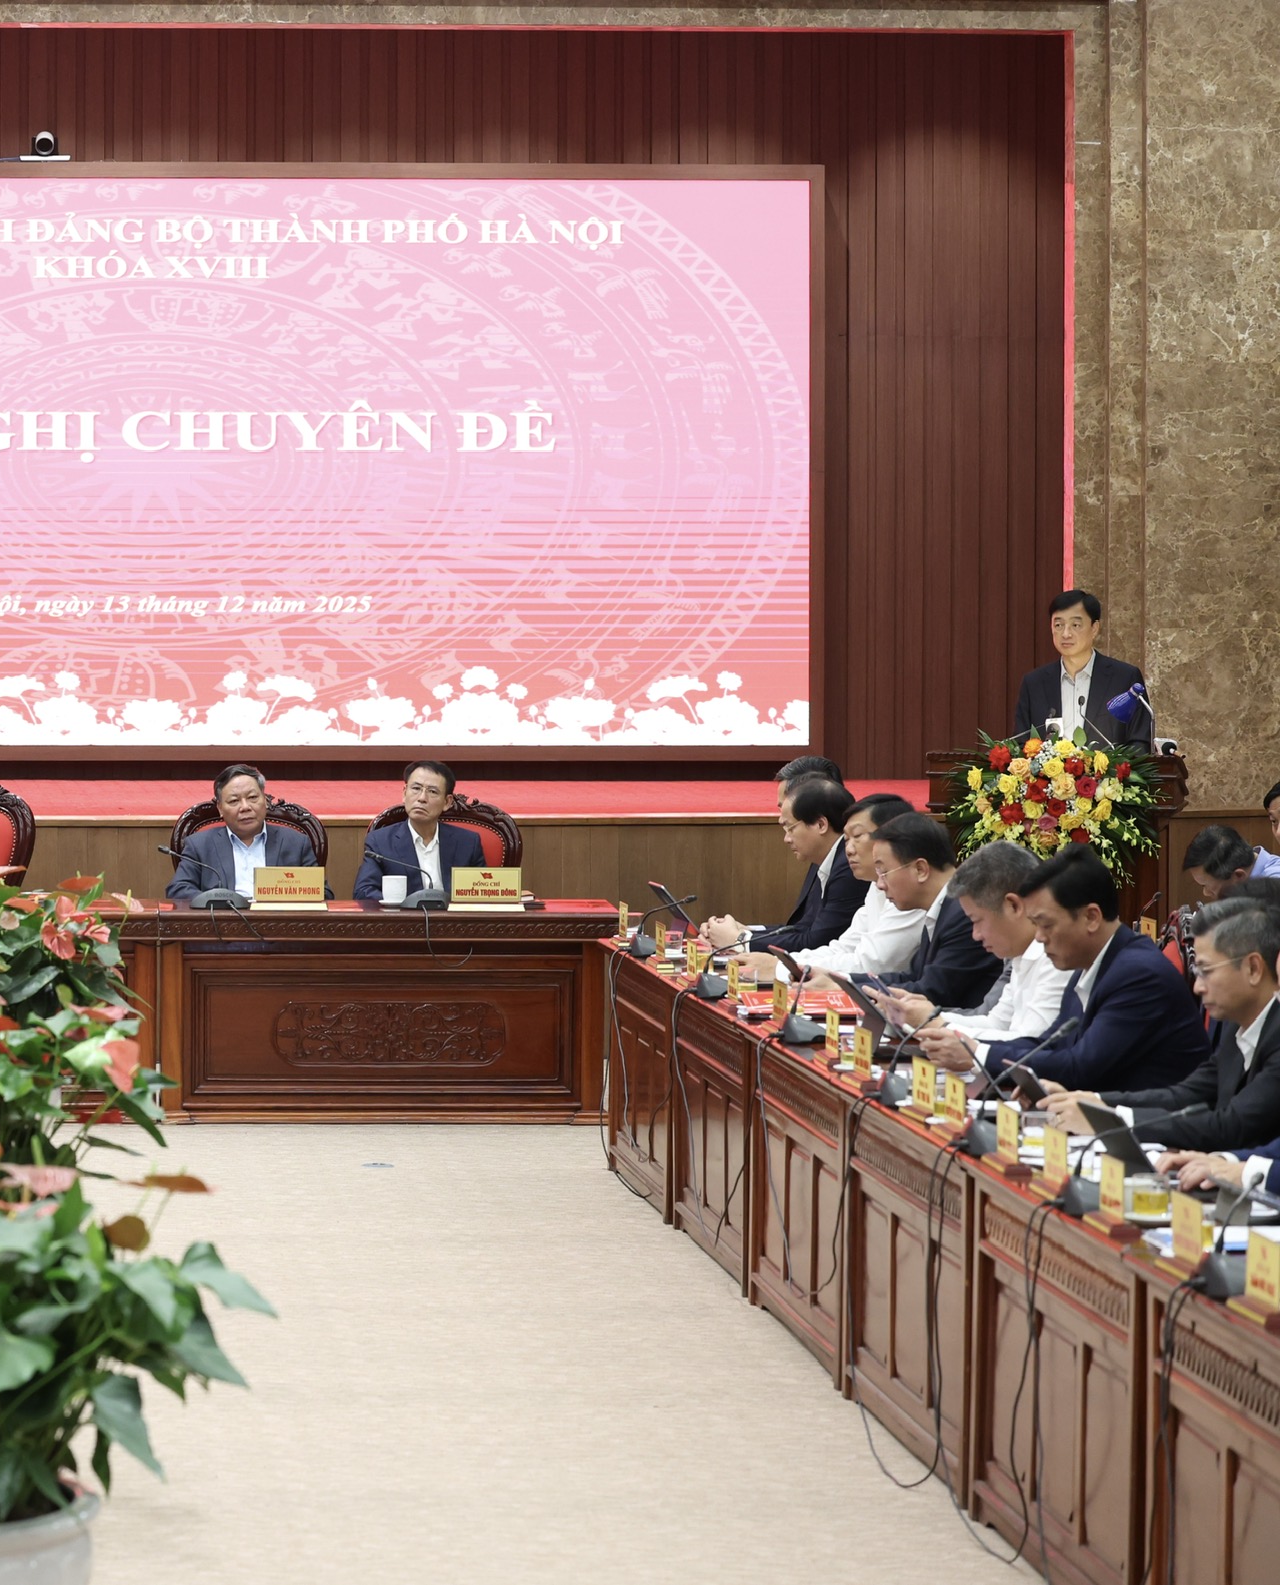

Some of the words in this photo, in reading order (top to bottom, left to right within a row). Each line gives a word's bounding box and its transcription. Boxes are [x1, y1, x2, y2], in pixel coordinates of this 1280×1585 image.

[25, 211, 146, 244] ĐẢNG
[156, 215, 214, 250] BỘ
[223, 212, 370, 244] THÀNH
[381, 212, 469, 244] PHỐ
[478, 212, 539, 244] HÀ
[548, 216, 624, 251] NỘI
[33, 249, 154, 279] KHÓA
[165, 256, 270, 279] XVIII
[121, 400, 437, 453] CHUYÊN
[456, 399, 556, 453] ĐỀ
[34, 596, 95, 617] ngày
[101, 595, 130, 613] 13
[137, 595, 208, 617] tháng
[215, 595, 246, 613] 12
[250, 596, 306, 613] năm
[312, 595, 374, 613] 2025
[257, 884, 283, 895] NGUYỄN
[284, 885, 297, 895] VĂN
[298, 886, 320, 895] PHONG
[455, 886, 479, 896] NGUYỄN
[480, 888, 499, 897] TRỌNG
